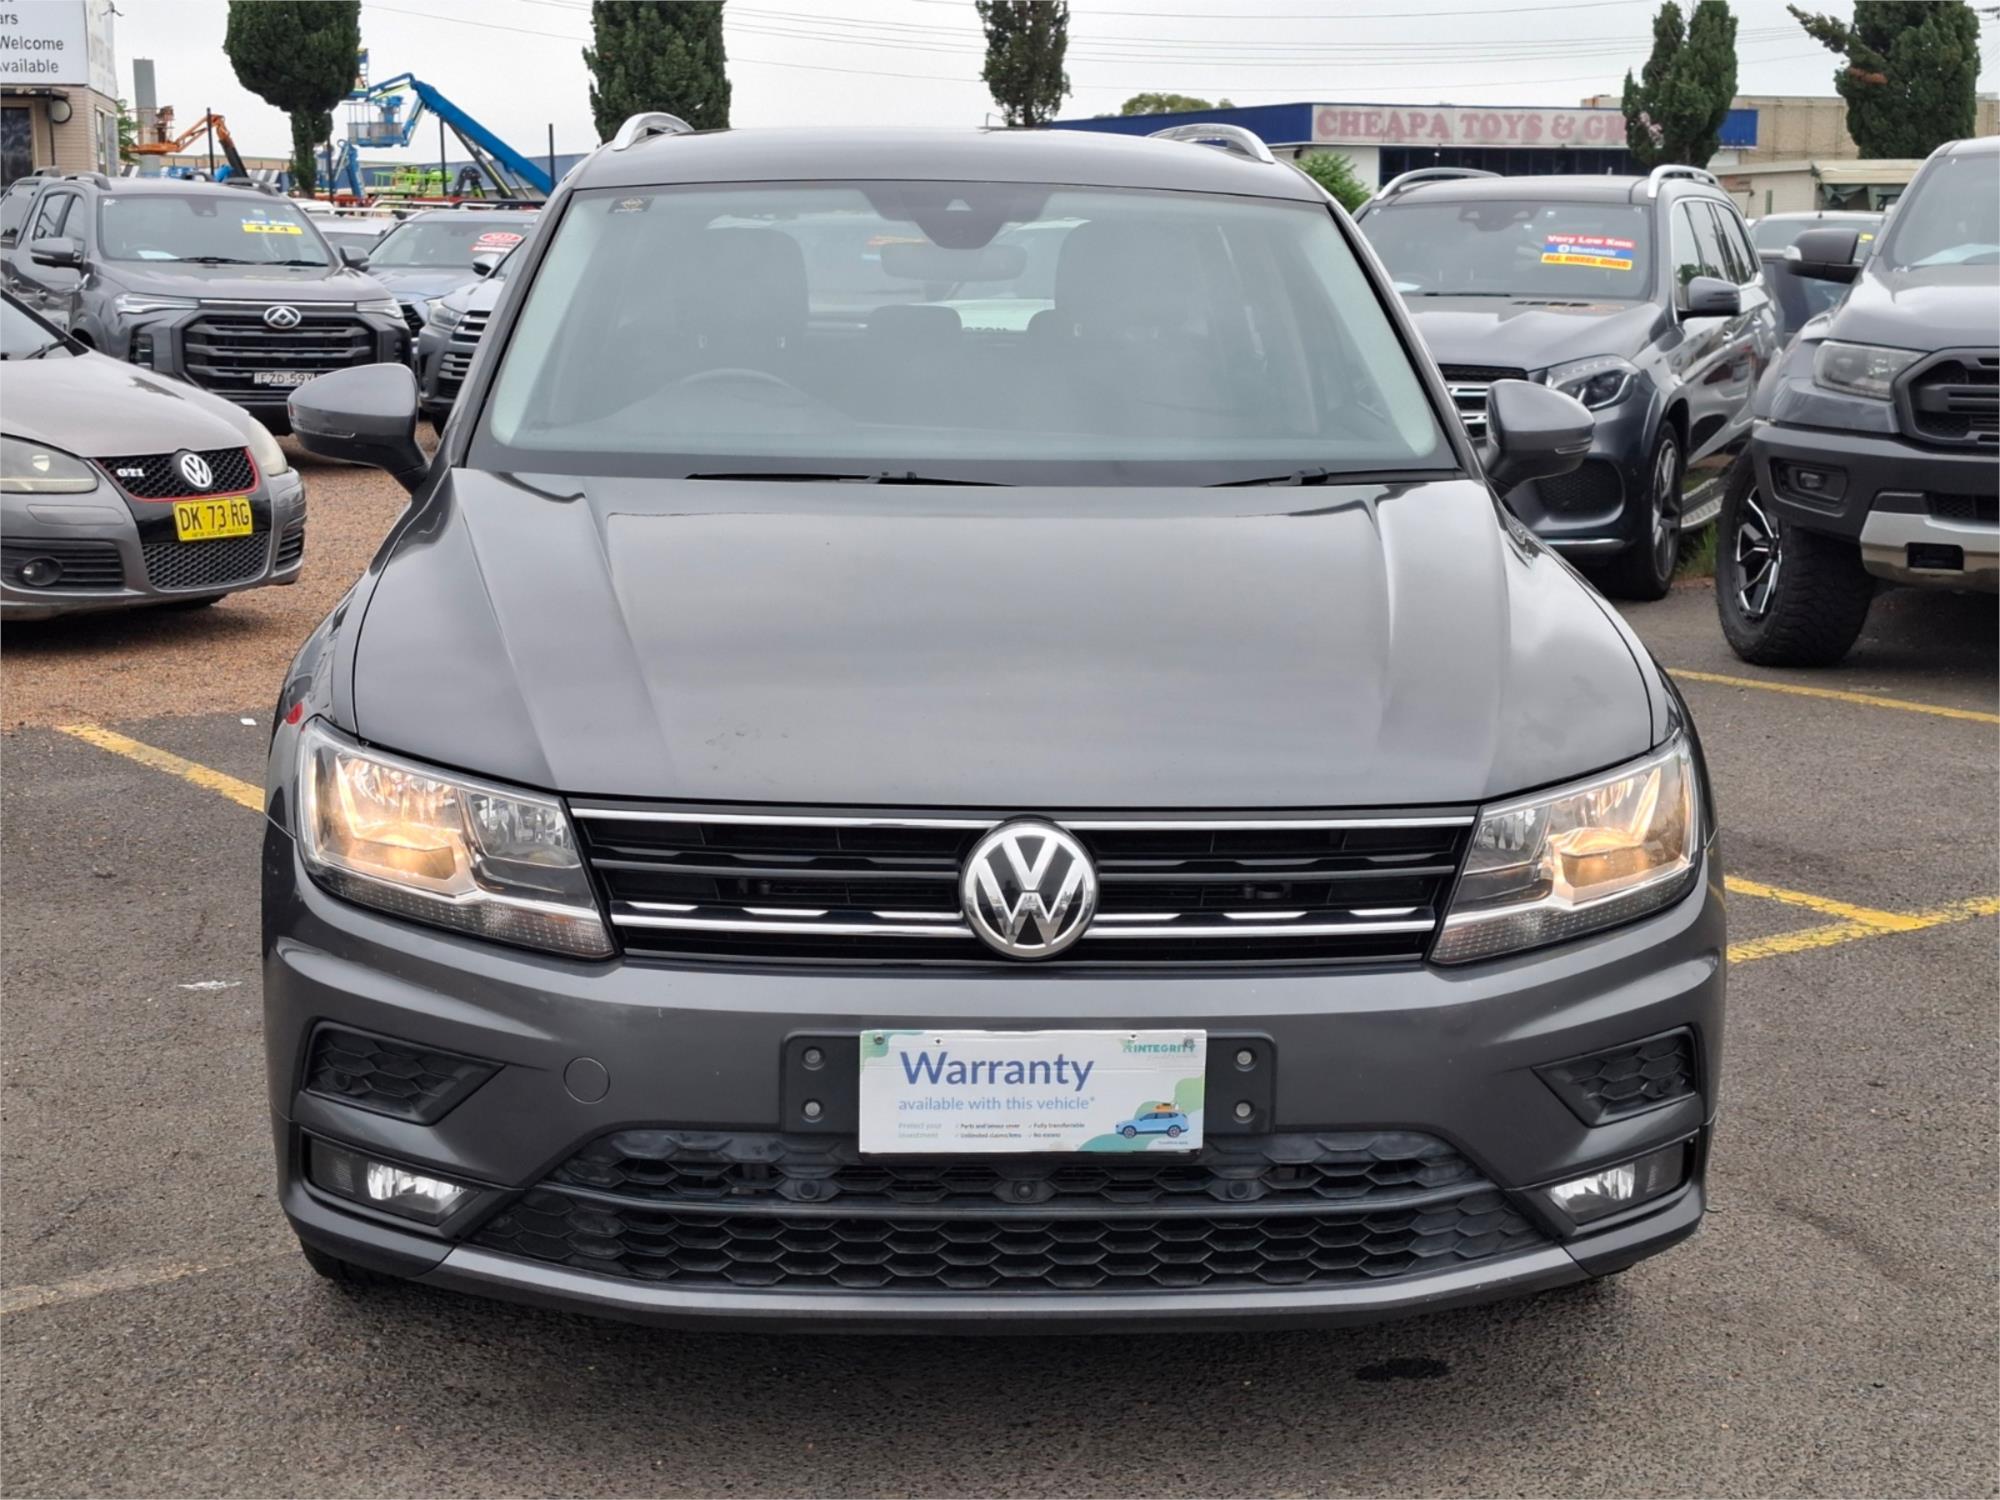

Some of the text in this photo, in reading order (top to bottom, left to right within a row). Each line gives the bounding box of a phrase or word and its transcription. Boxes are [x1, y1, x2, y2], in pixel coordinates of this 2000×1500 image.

[0, 59, 59, 73] vailable
[1317, 110, 1451, 139] CHEAPA
[1460, 113, 1543, 140] TOYS
[1551, 114, 1576, 140] &
[178, 502, 250, 532] DK 73 RG
[900, 1051, 1094, 1091] Warranty
[898, 1097, 964, 1111] available
[969, 1097, 1001, 1110] with
[1006, 1096, 1033, 1110] this
